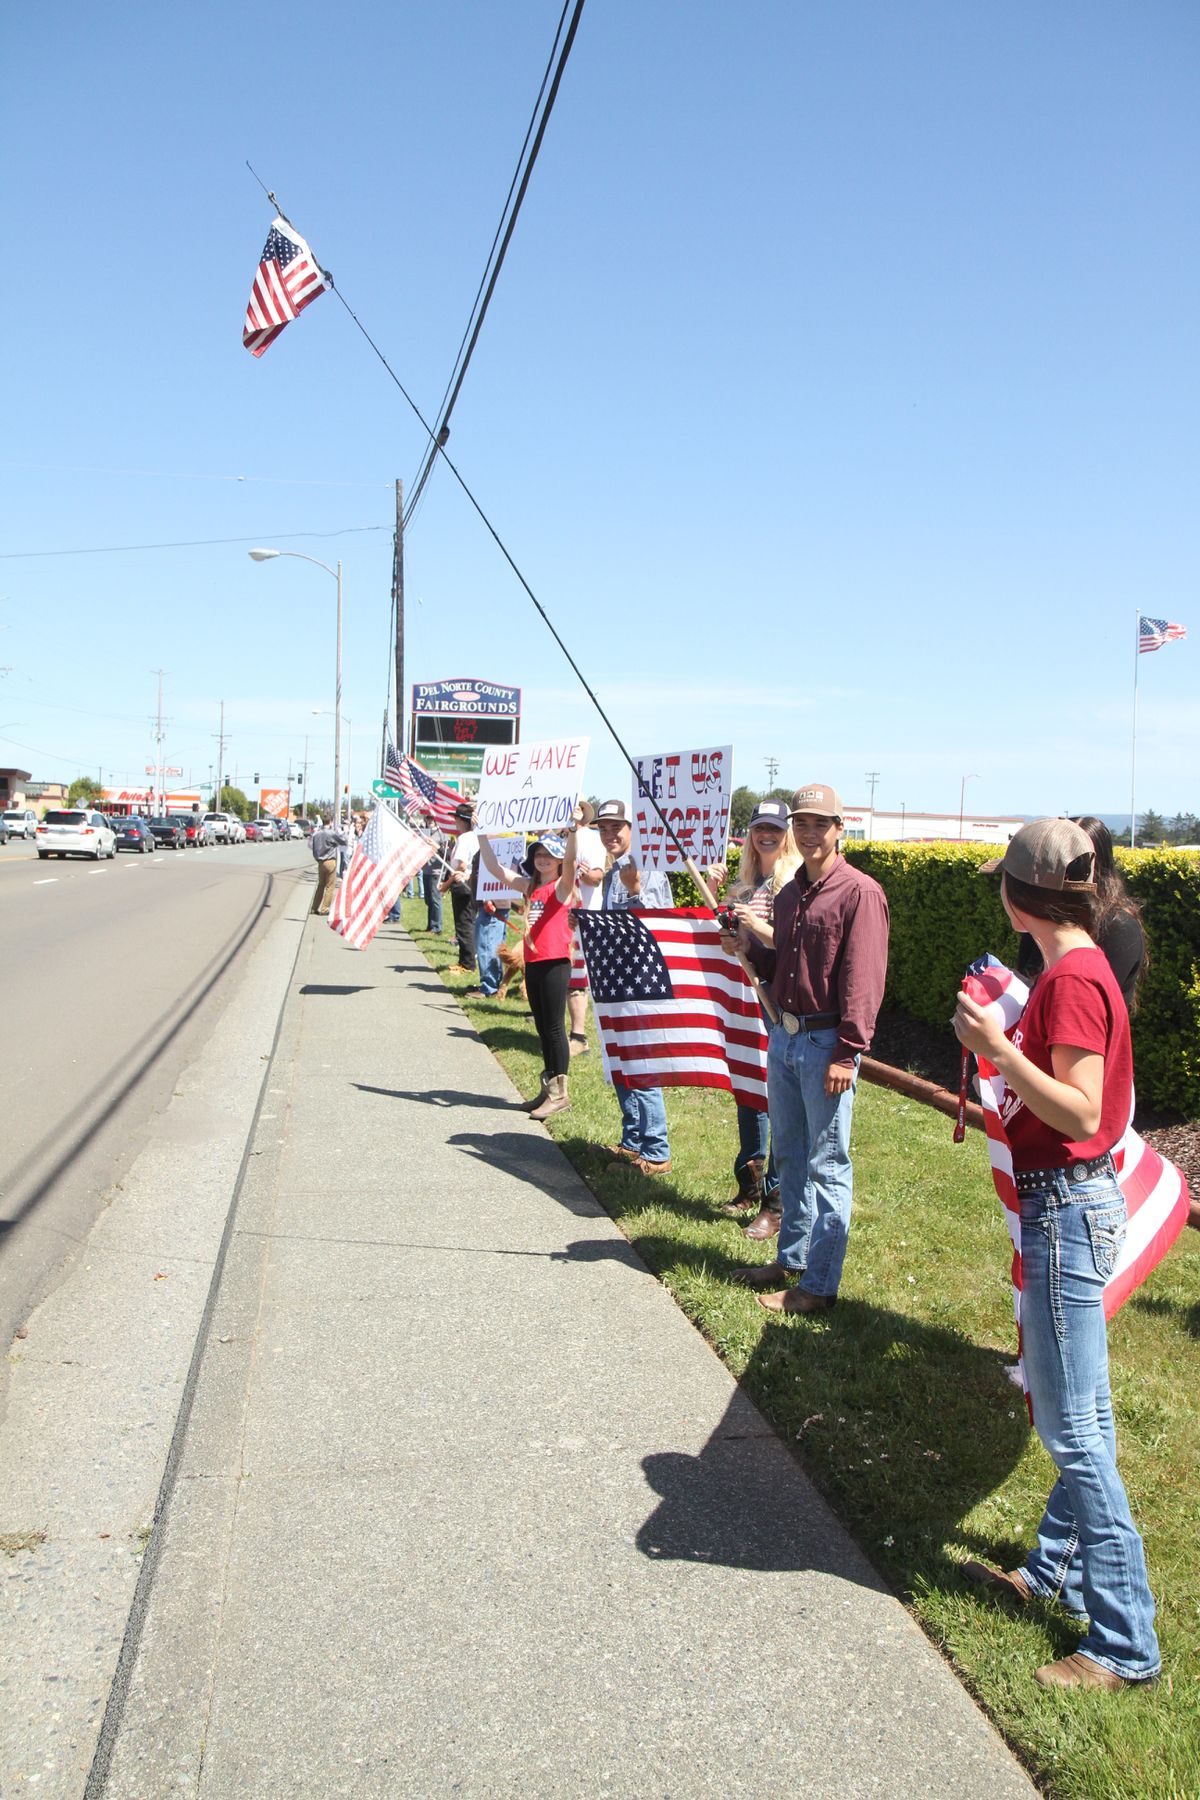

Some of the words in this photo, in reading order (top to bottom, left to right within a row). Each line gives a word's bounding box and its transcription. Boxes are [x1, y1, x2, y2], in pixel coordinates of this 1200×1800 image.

[419, 686, 440, 697] DEL
[440, 682, 472, 693] NORTE
[474, 682, 515, 700] COUNTY
[416, 698, 517, 713] FAIRGROUNDS
[485, 752, 520, 776] WE
[528, 744, 581, 771] HAVE
[521, 775, 534, 789] A
[637, 757, 681, 799] LET
[477, 793, 578, 829] CONSTITUTION
[842, 816, 864, 824] rmacy
[637, 793, 731, 869] WORK!
